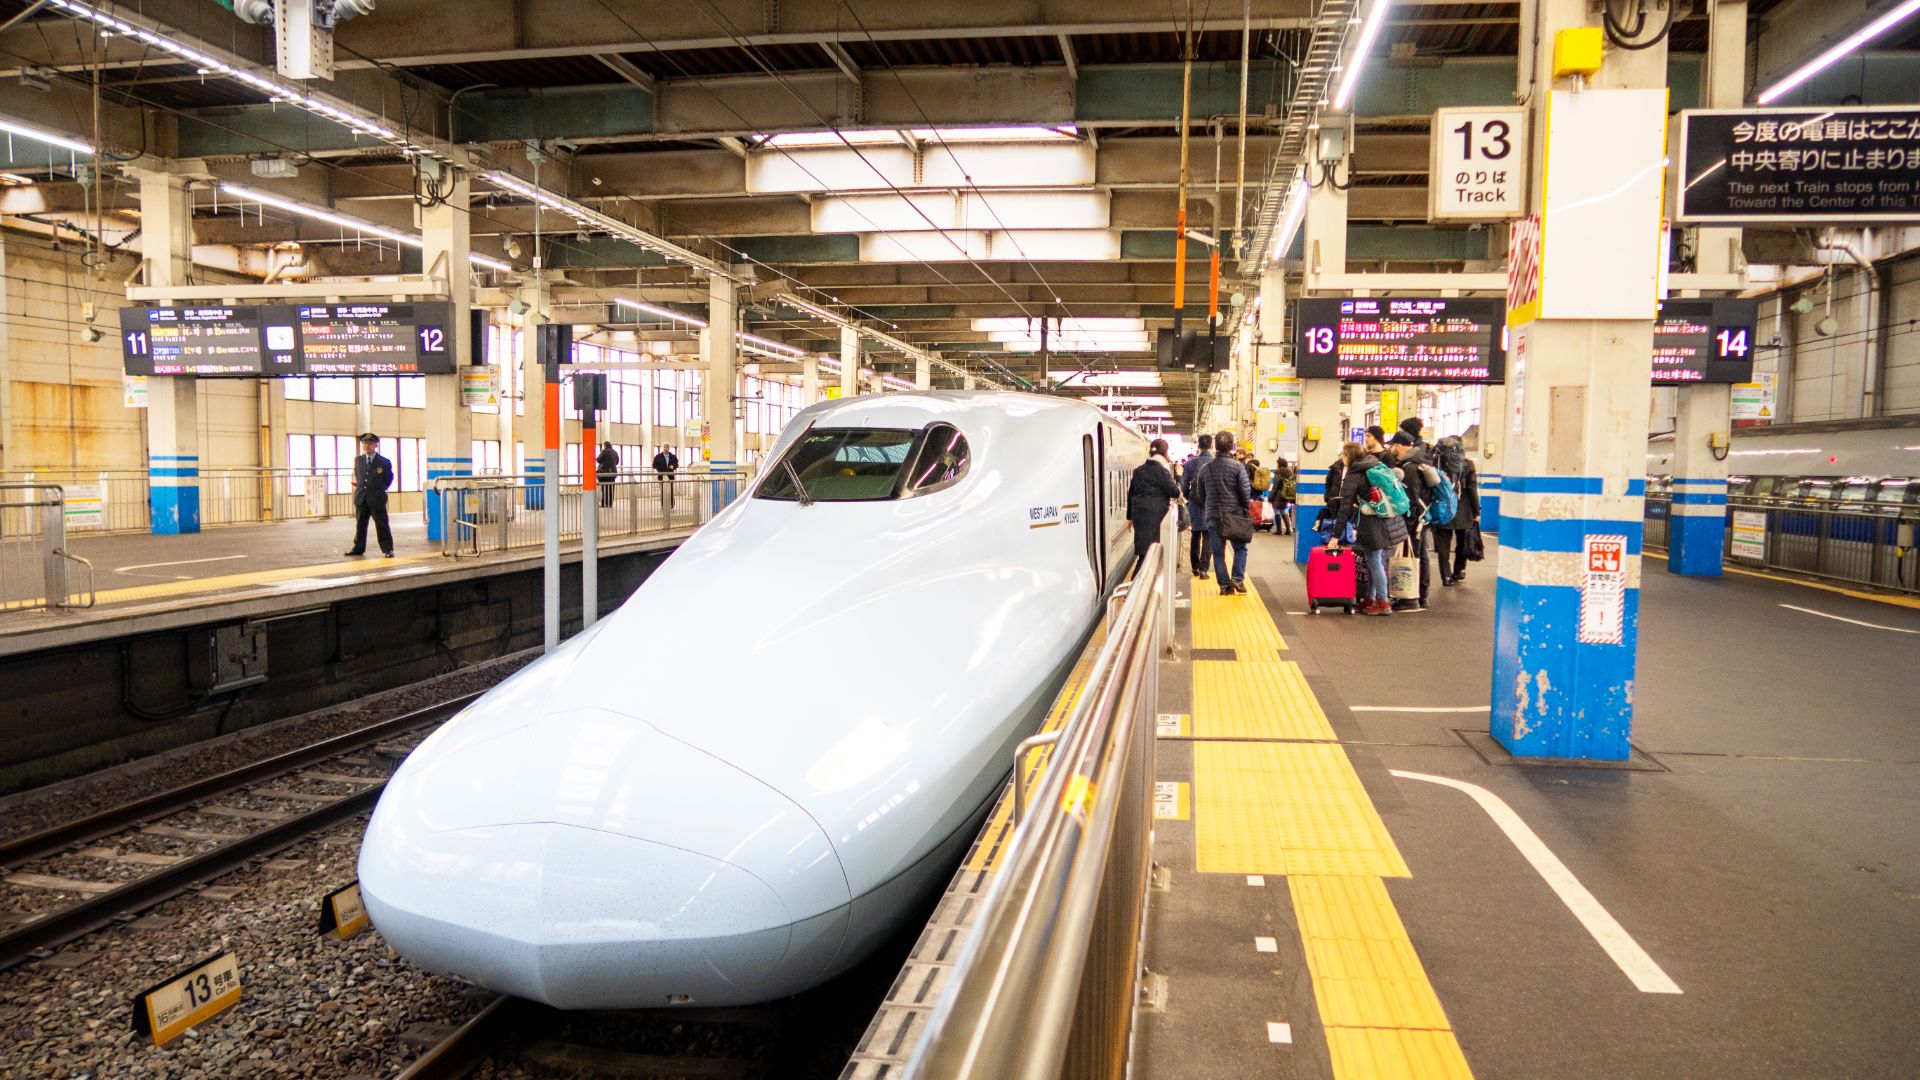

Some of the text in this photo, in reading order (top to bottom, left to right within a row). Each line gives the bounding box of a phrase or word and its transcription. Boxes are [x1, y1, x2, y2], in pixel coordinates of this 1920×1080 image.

[1454, 120, 1511, 160] 13
[1456, 171, 1507, 184] のりば
[1456, 188, 1506, 202] Track
[1728, 182, 1754, 194] The
[1760, 182, 1790, 194] next
[1795, 181, 1830, 193] Train
[1835, 182, 1873, 195] stops
[1879, 180, 1910, 192] from
[1728, 196, 1777, 208] Toward
[1782, 196, 1804, 208] the
[1809, 196, 1855, 208] Center
[1861, 195, 1875, 207] of
[1881, 195, 1906, 207] this
[127, 332, 147, 355] 11
[420, 329, 444, 352] 12
[1305, 327, 1334, 354] 13
[1716, 329, 1748, 357] 14
[1030, 505, 1058, 520] WEST JAPAN
[1591, 543, 1620, 552] STOP
[213, 969, 233, 986] 号車
[184, 973, 212, 1008] 13
[157, 1011, 169, 1026] 16
